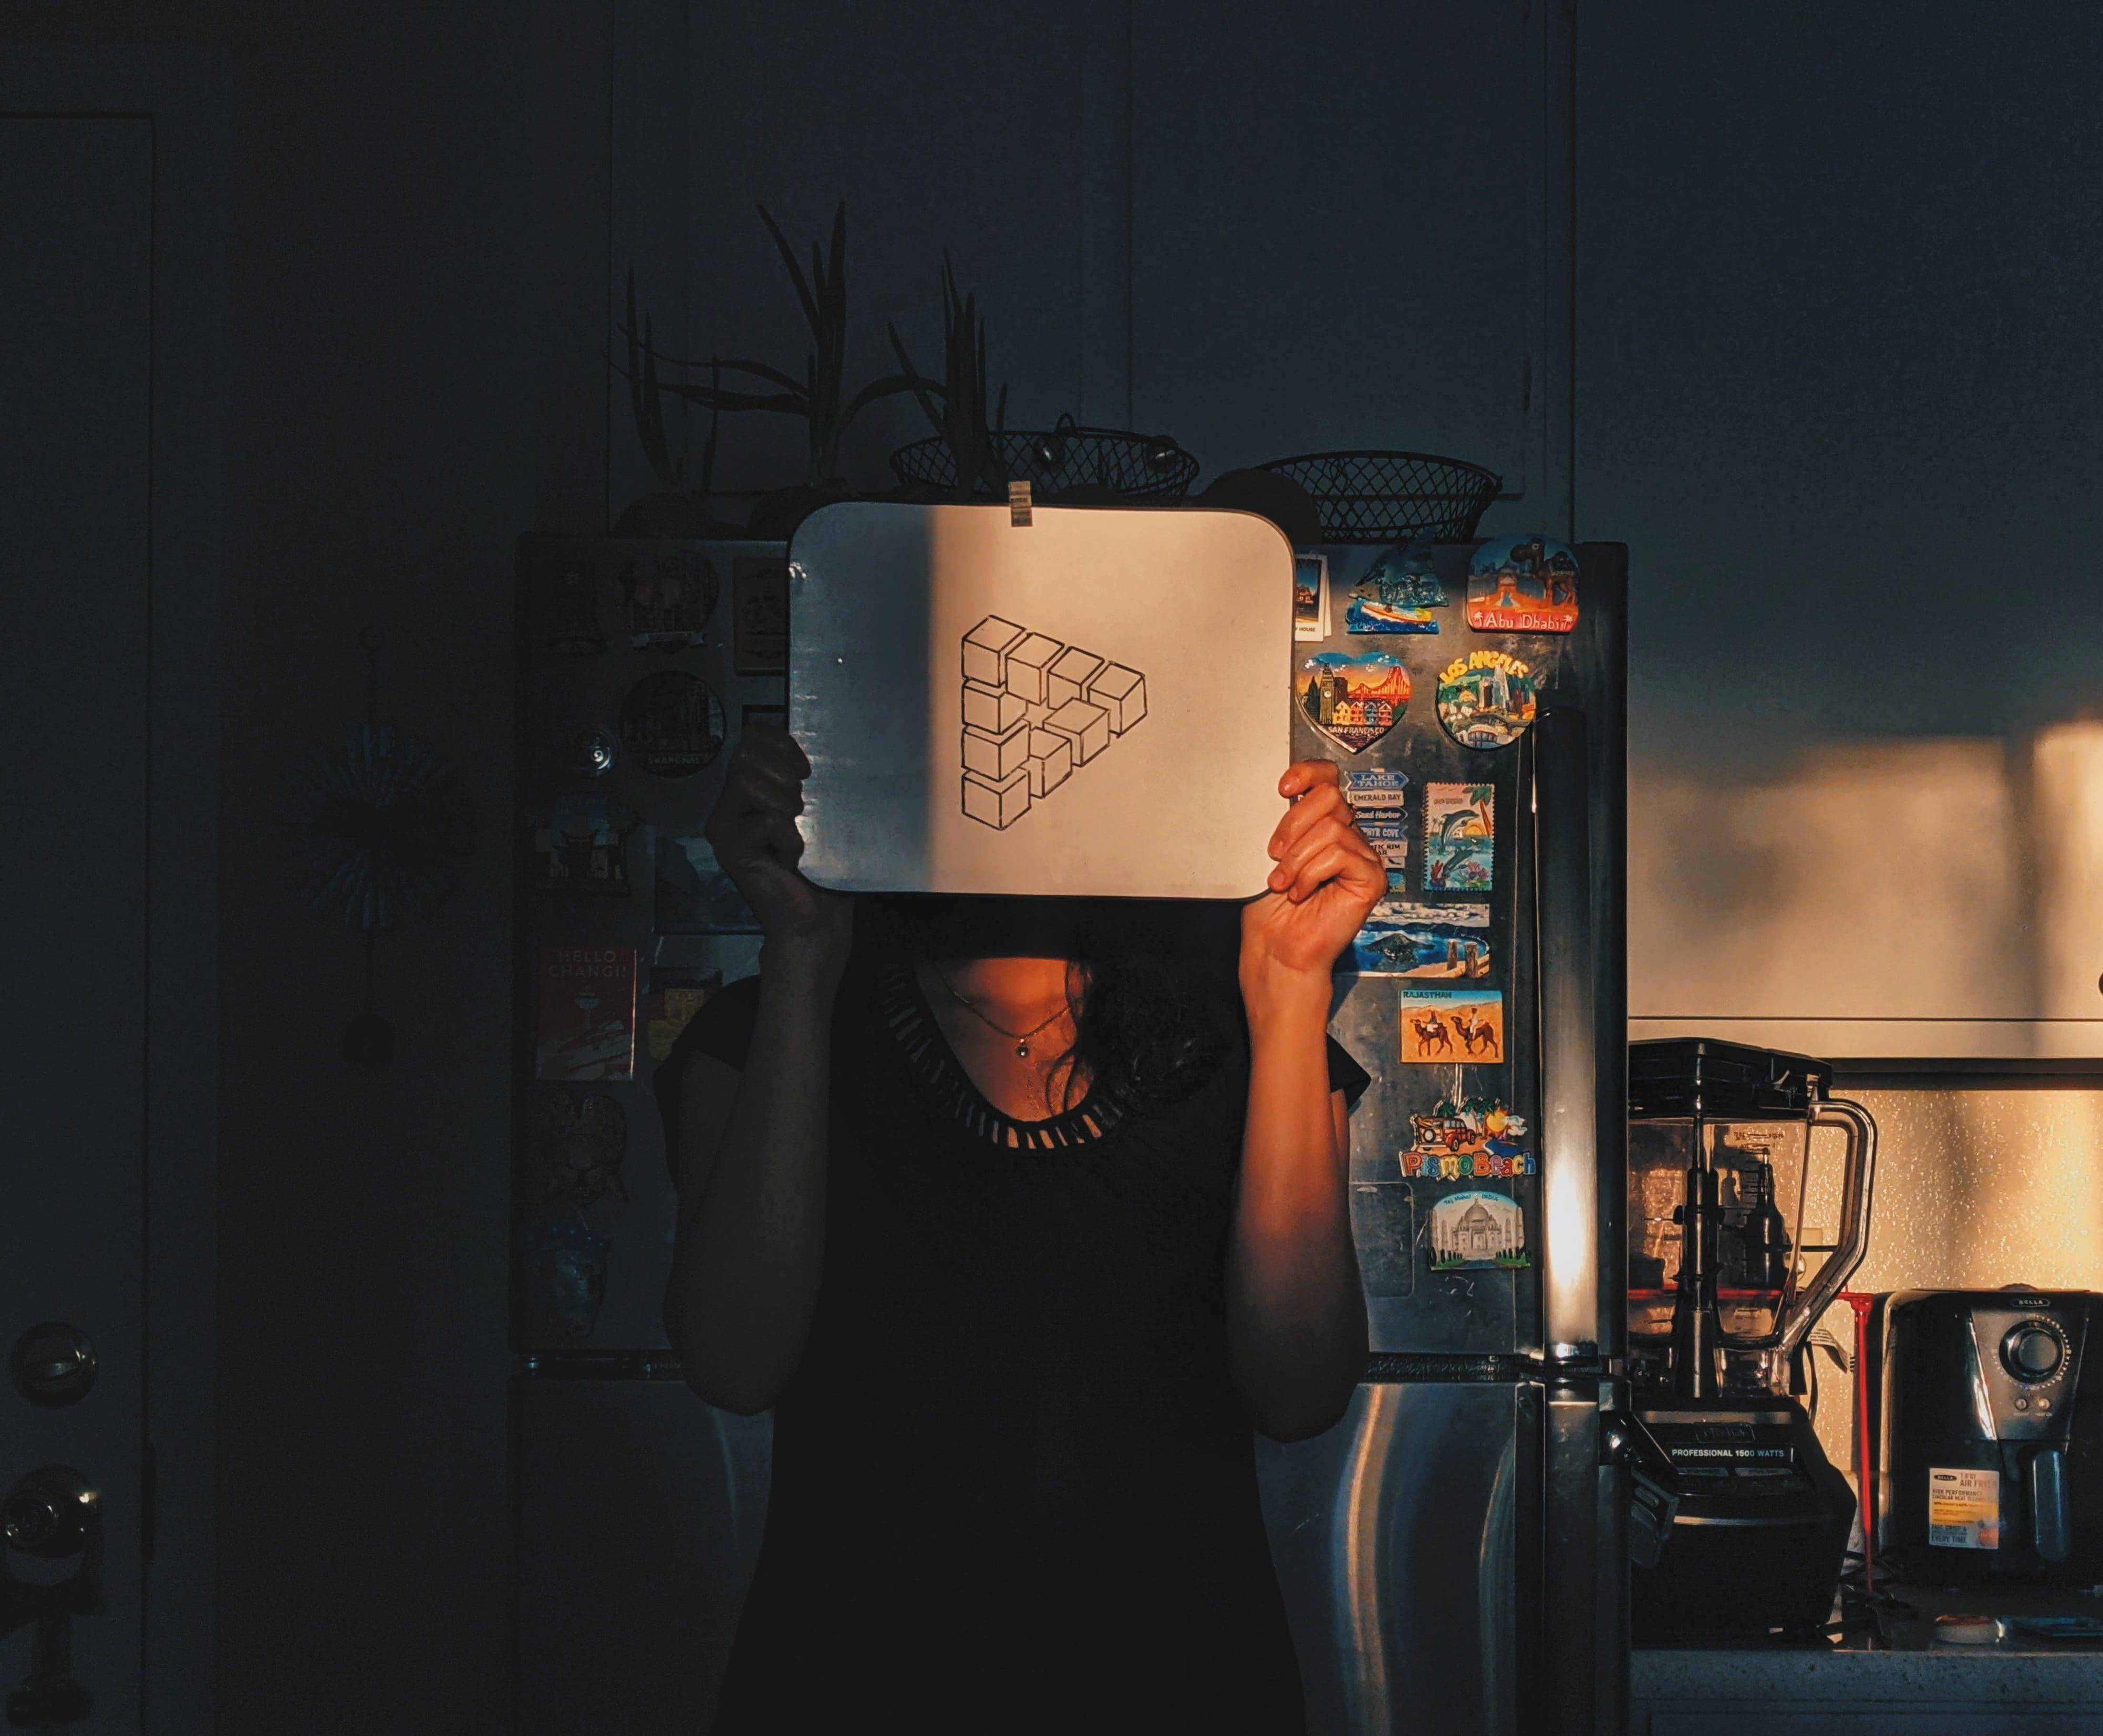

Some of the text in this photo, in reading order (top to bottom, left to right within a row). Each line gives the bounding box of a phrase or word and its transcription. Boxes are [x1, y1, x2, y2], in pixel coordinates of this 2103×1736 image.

[1485, 612, 1559, 629] Abu Dhabi
[1439, 651, 1529, 684] LOS ANGELES
[1344, 726, 1384, 735] FRANCISCO
[1383, 828, 1400, 837] COVE
[558, 950, 617, 963] HELLO
[1672, 1449, 1733, 1457] PROFESSIONAL
